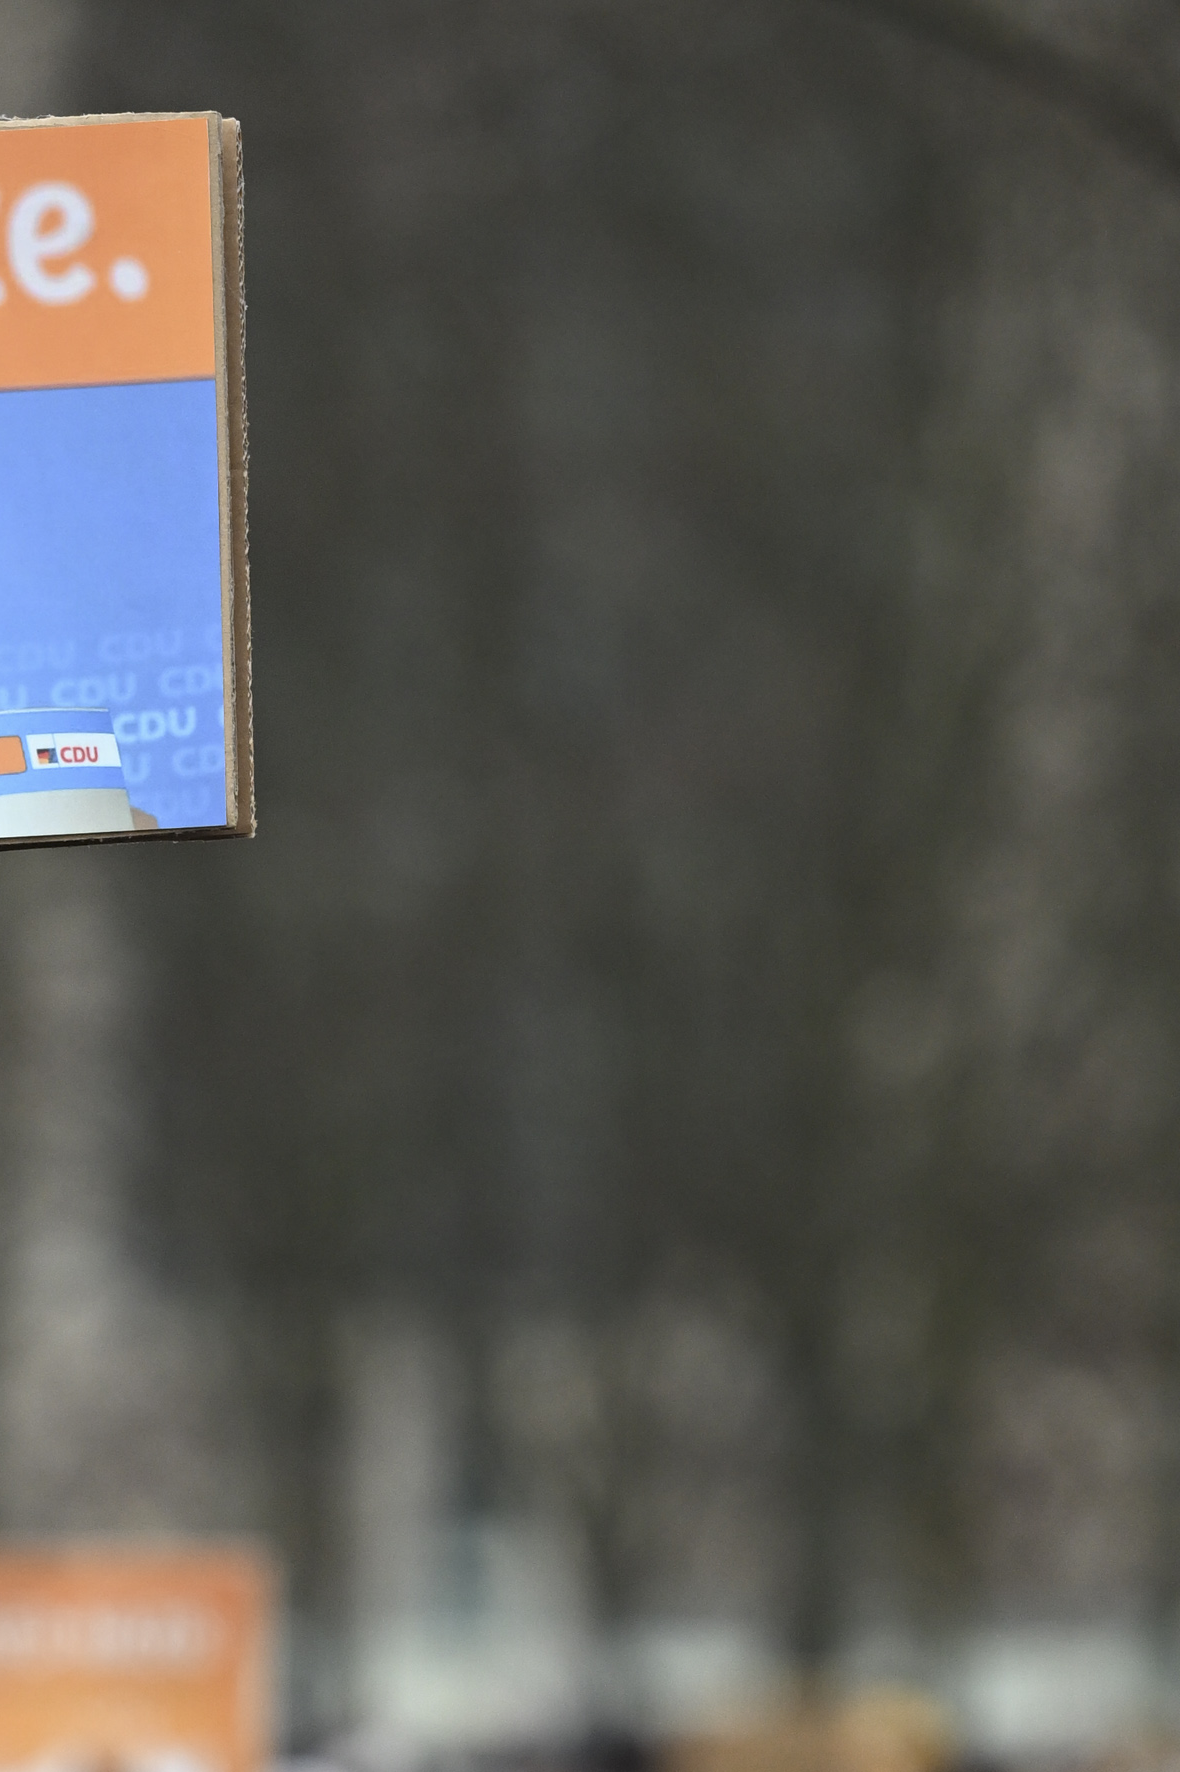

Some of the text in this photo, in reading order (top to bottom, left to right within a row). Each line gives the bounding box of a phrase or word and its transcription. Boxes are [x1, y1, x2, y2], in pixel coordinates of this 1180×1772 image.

[51, 672, 137, 706] CDU
[159, 664, 222, 697] CD
[115, 706, 197, 743] CDU
[60, 745, 99, 764] CDU
[173, 745, 223, 777] CD
